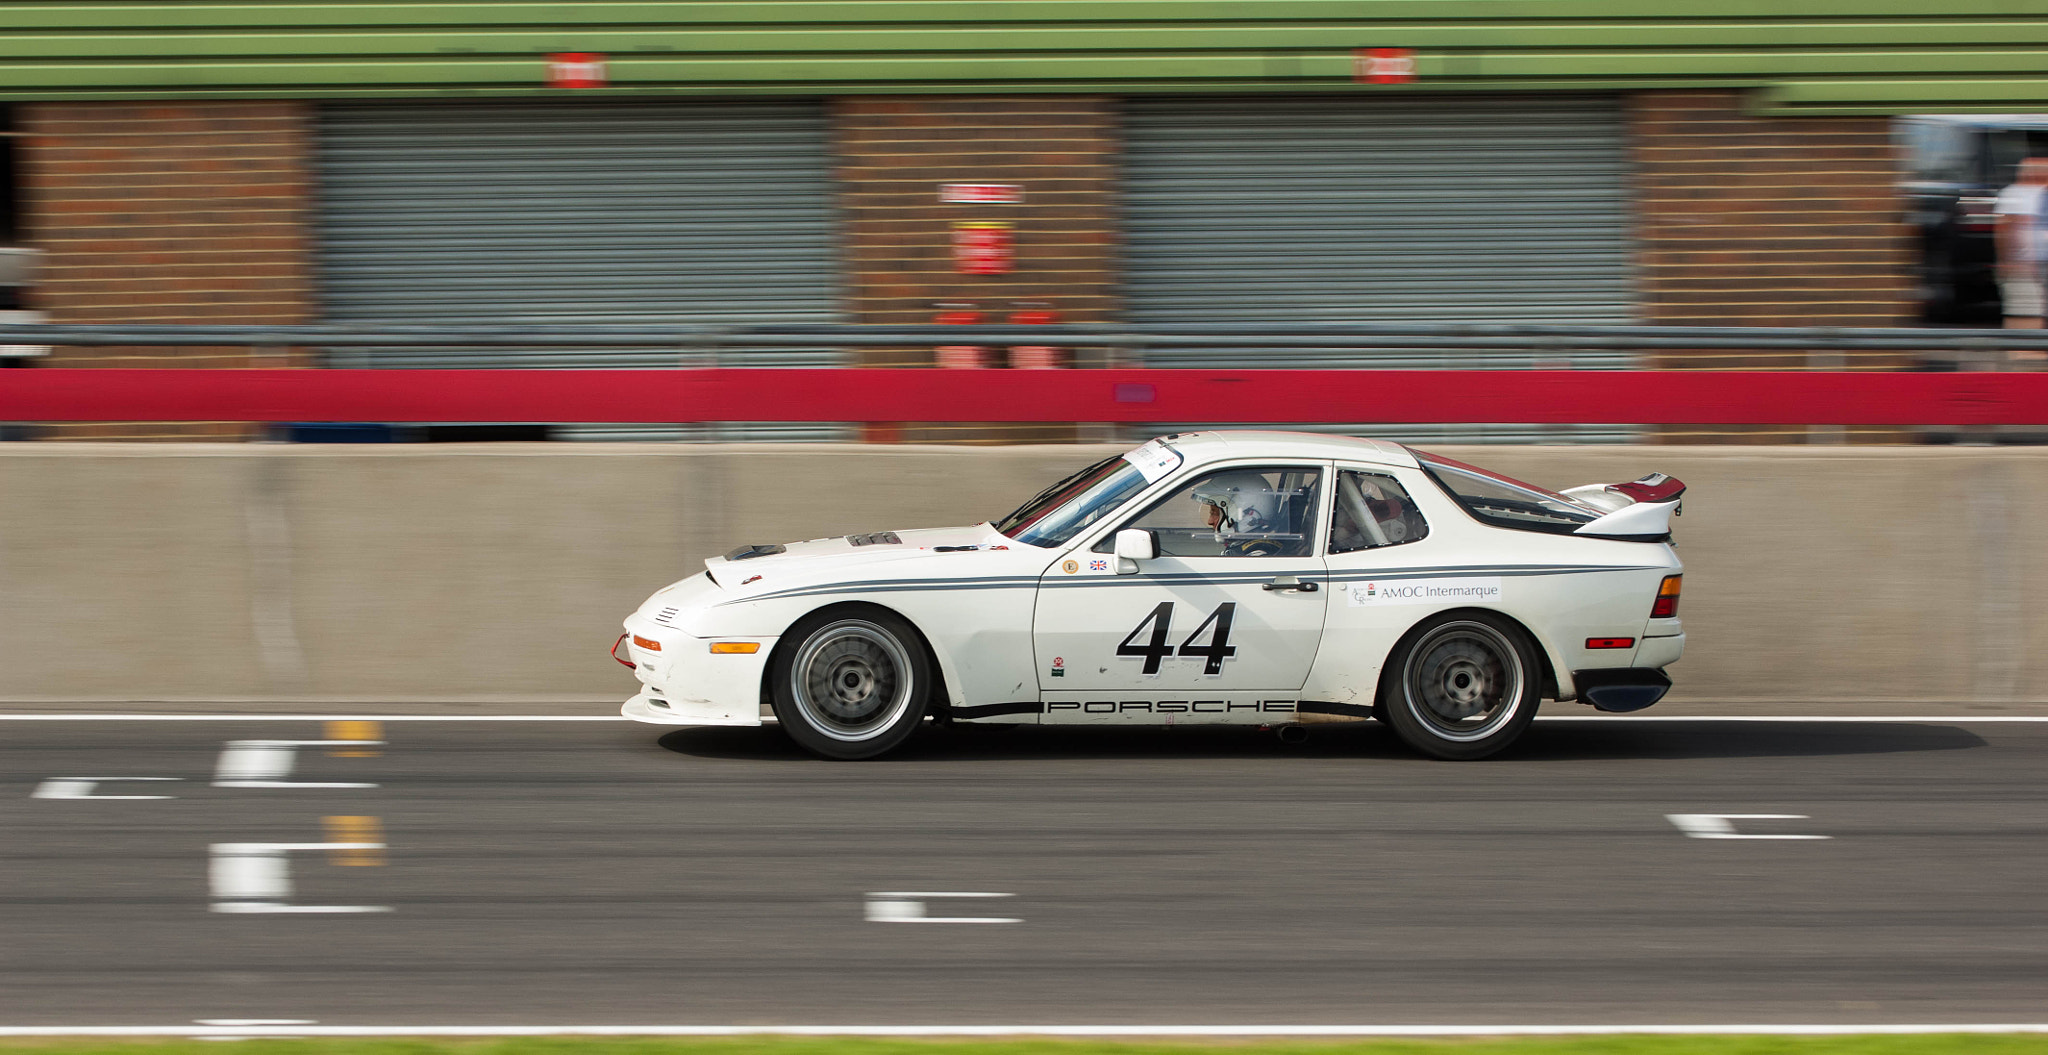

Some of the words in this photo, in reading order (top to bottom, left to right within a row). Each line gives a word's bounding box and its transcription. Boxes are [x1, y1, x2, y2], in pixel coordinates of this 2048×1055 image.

[1380, 586, 1423, 598] AMOC
[1426, 586, 1498, 598] Intermarque
[1116, 601, 1236, 676] 44
[1047, 700, 1296, 713] PORSCHE
